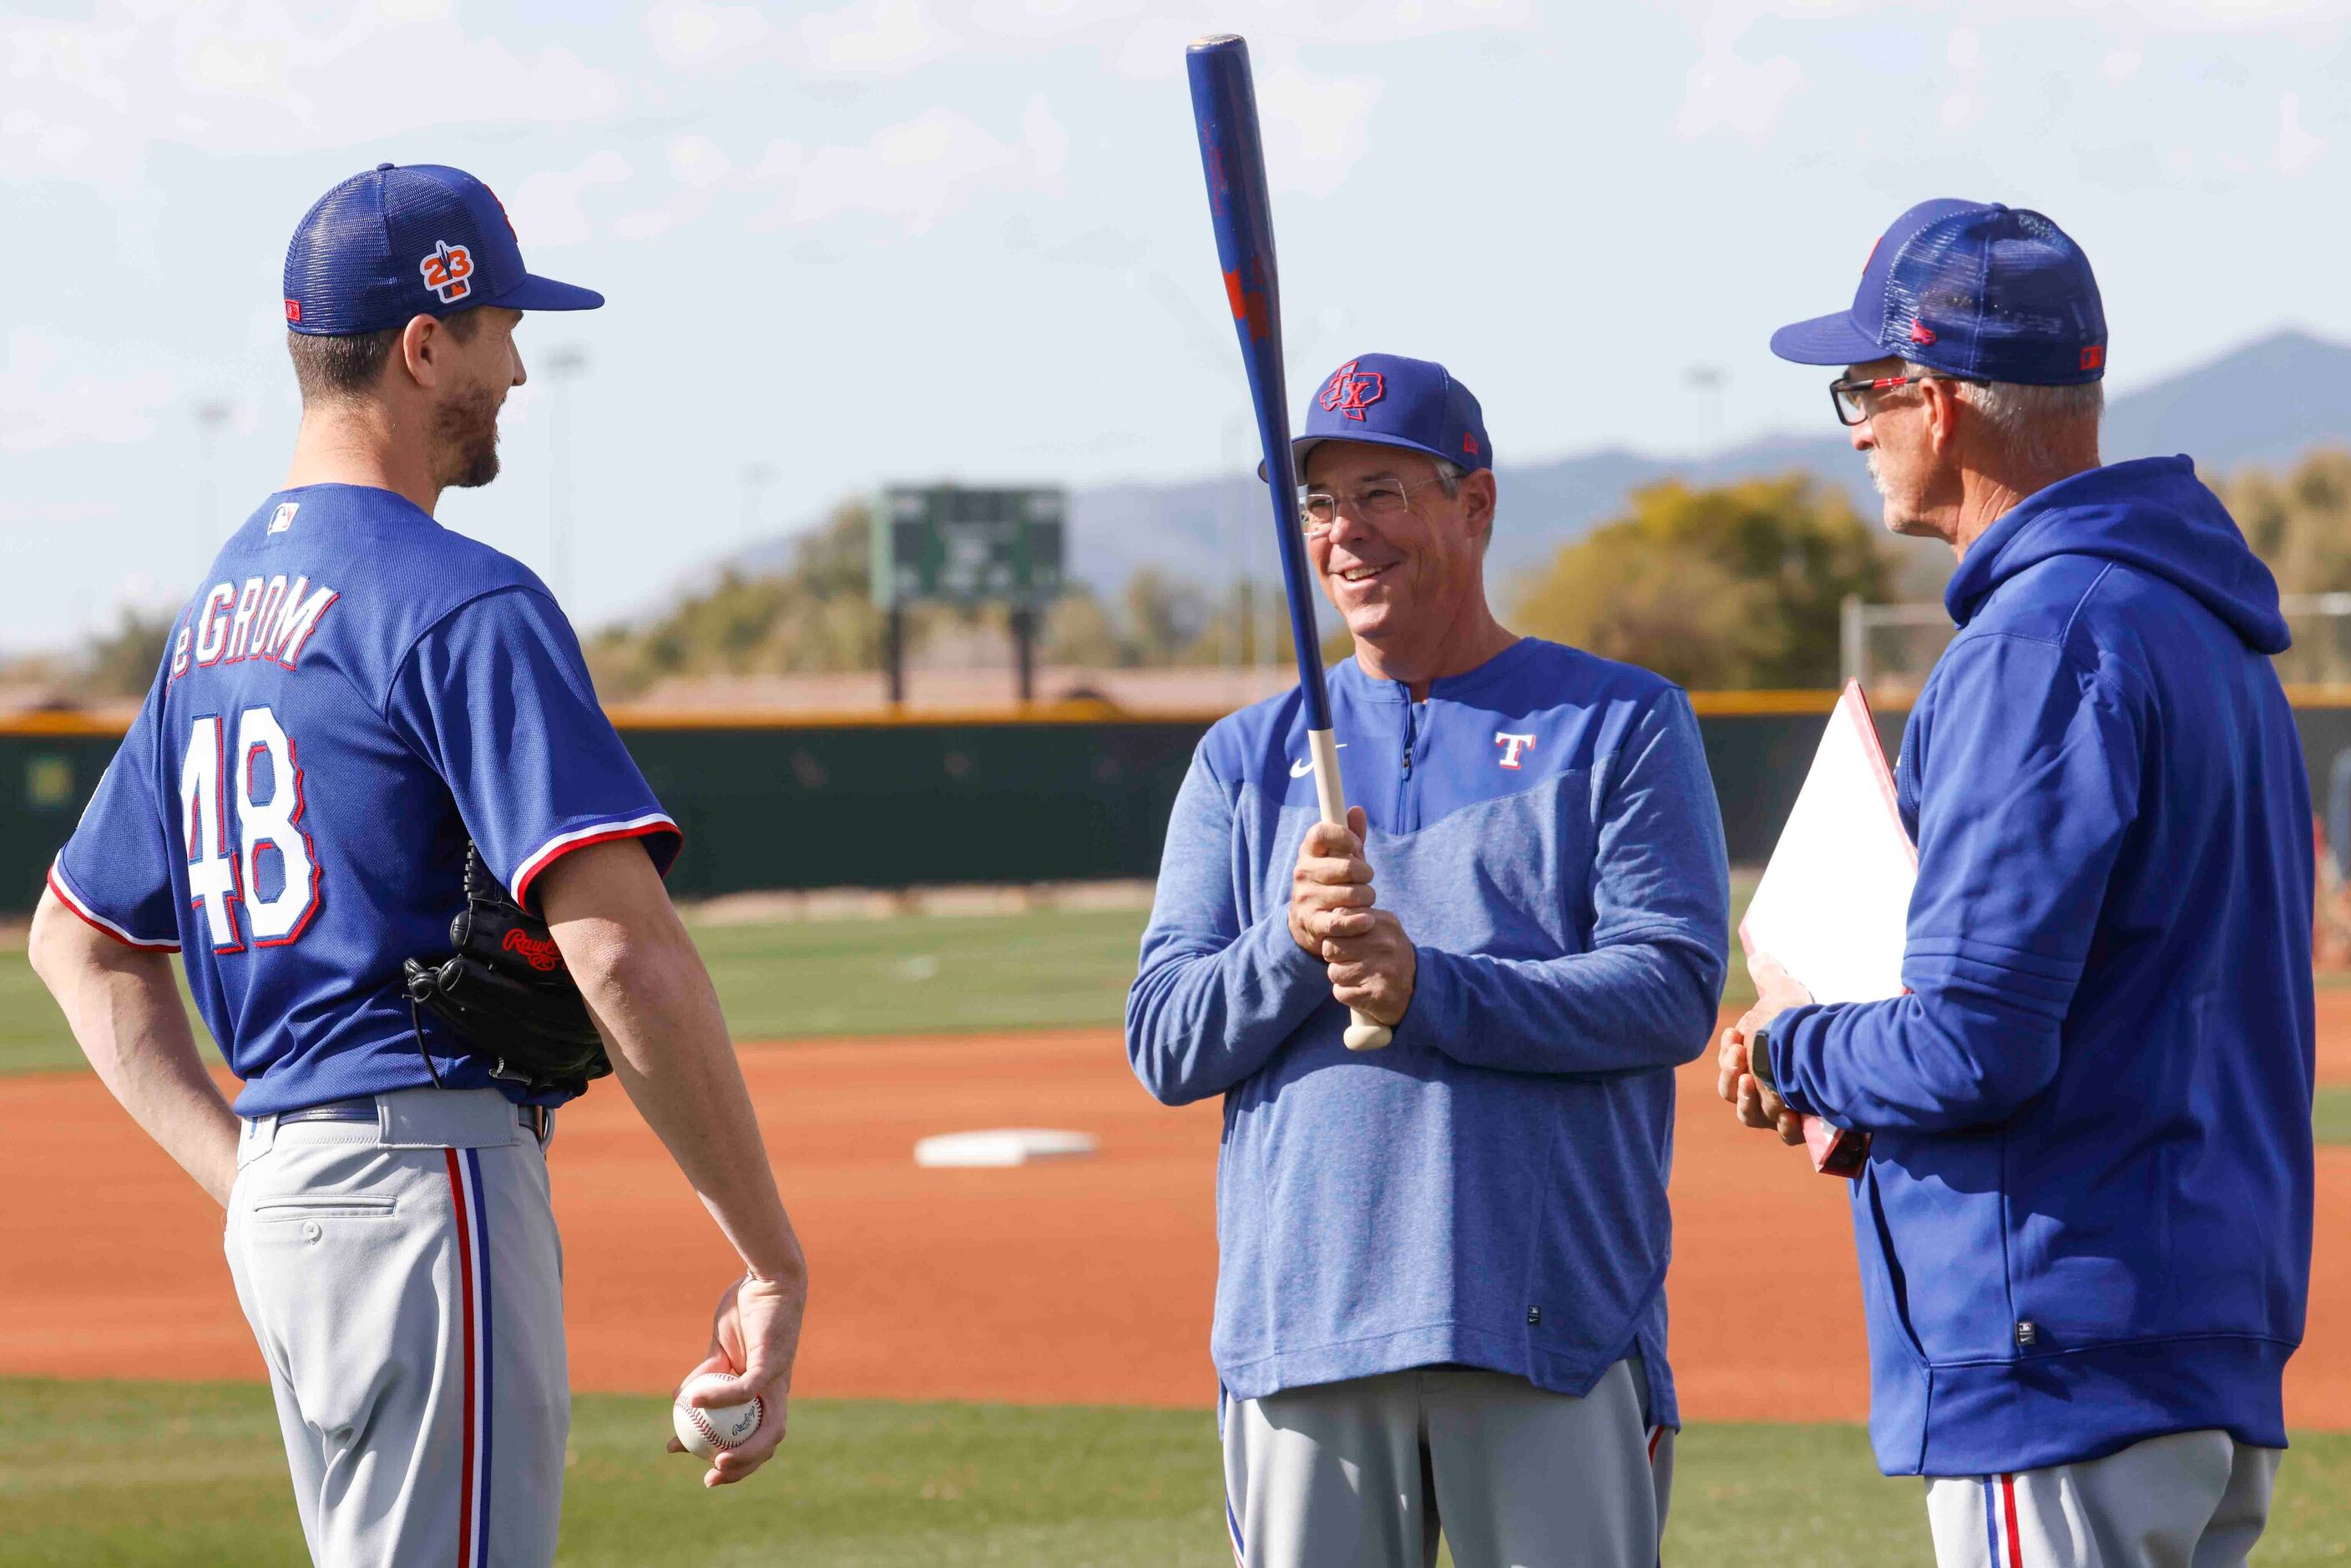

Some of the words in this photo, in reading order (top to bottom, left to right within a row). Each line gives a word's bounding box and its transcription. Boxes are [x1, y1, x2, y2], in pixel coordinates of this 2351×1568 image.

[423, 249, 471, 286] 23
[166, 574, 341, 695] eGROM
[1495, 731, 1536, 770] T
[180, 703, 322, 954] 48
